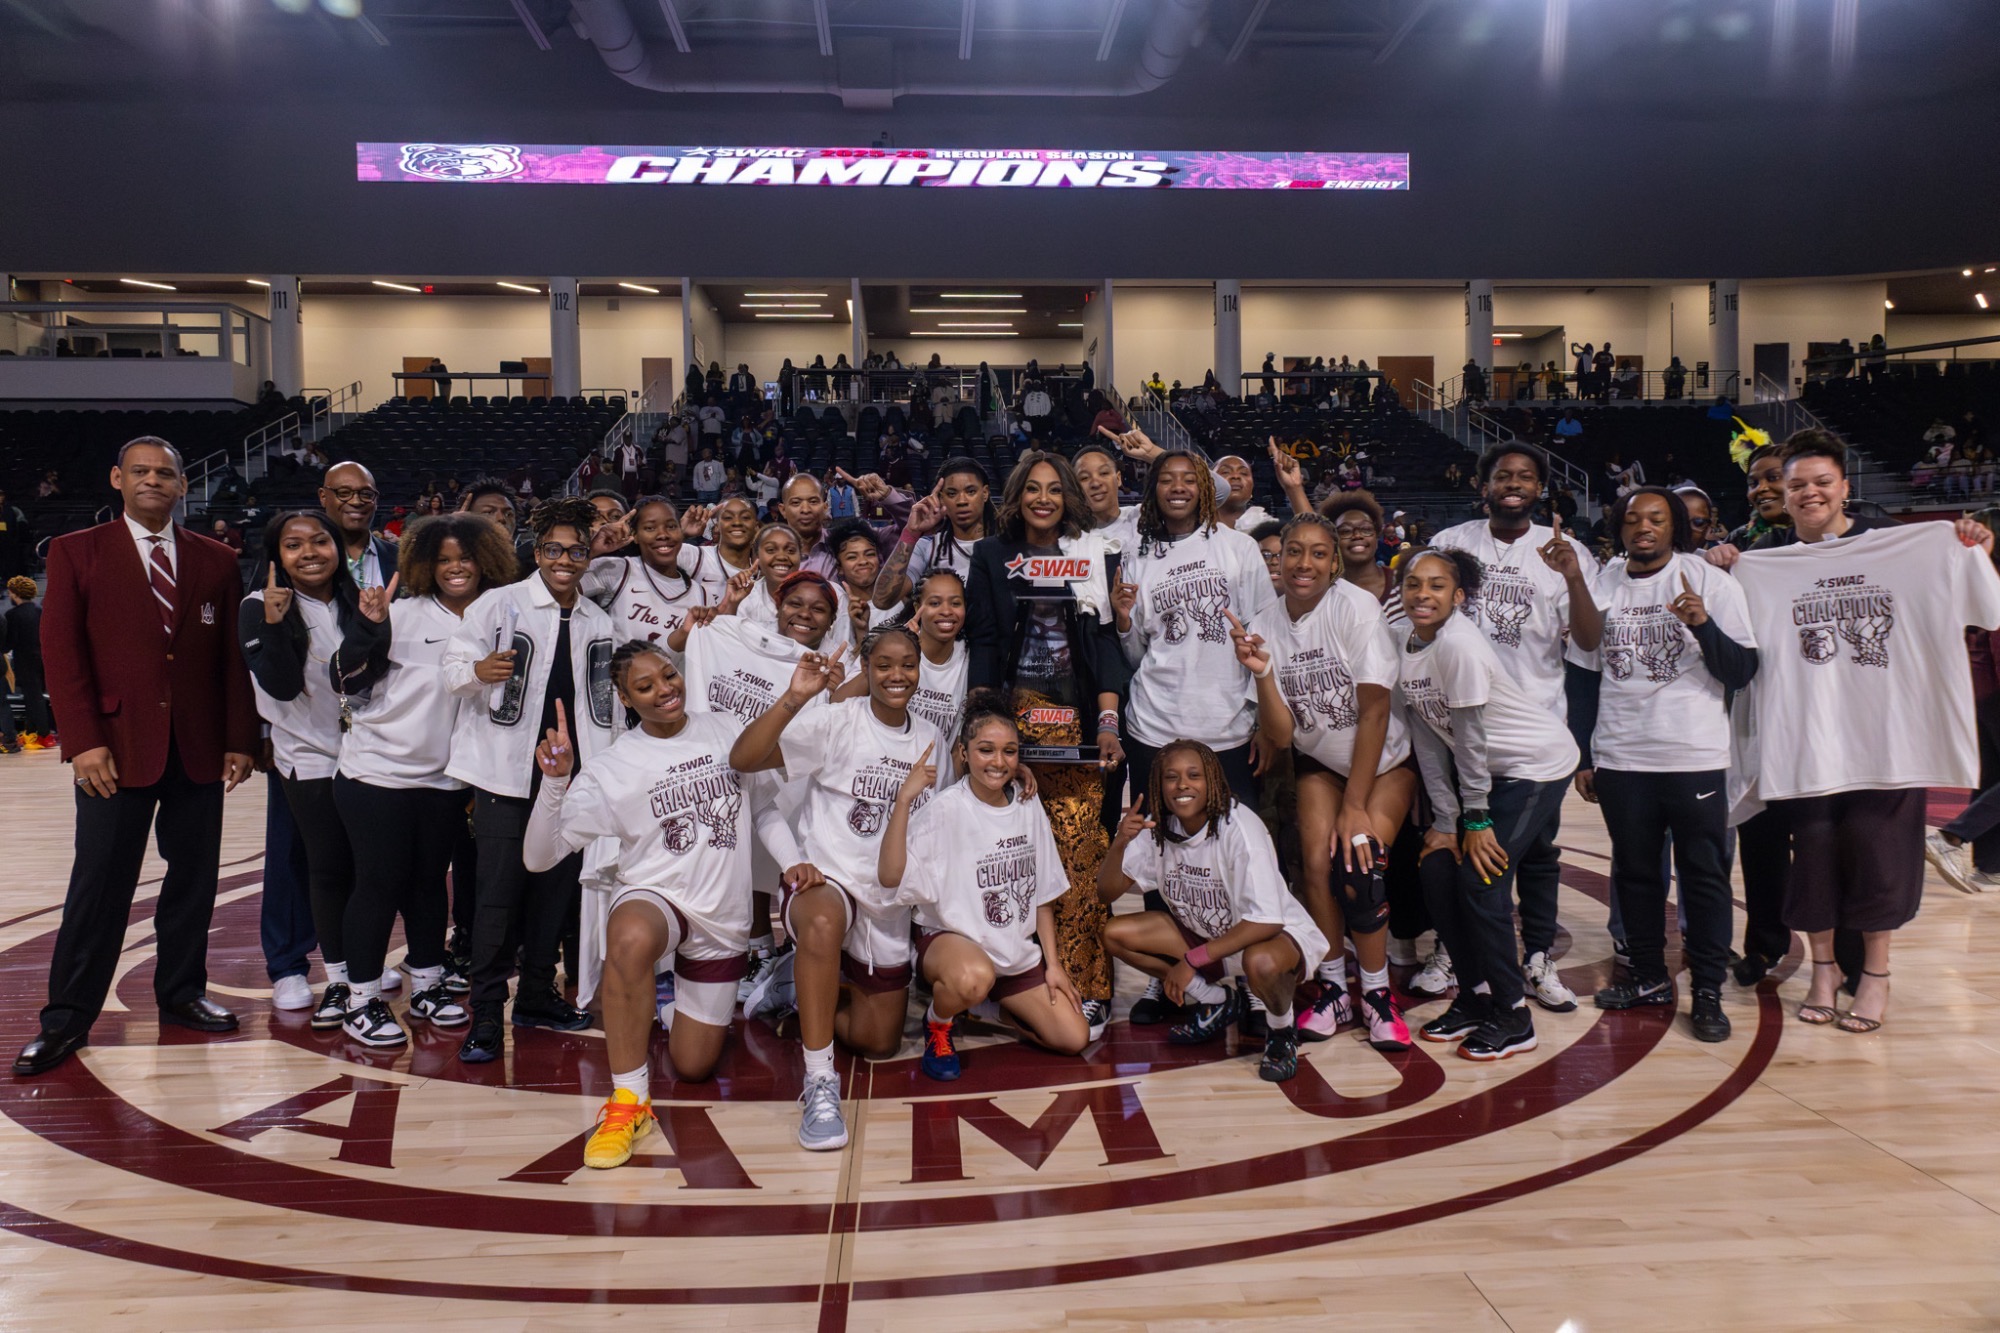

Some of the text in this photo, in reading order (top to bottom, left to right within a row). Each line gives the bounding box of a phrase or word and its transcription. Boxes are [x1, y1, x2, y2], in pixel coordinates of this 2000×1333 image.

[714, 148, 805, 157] SWAC
[936, 150, 1039, 159] REGULAR
[1045, 152, 1134, 160] SEASON
[606, 156, 1169, 187] CHAMPIONS
[273, 291, 287, 309] 111
[554, 293, 570, 311] 112
[1223, 294, 1237, 312] 114
[1029, 559, 1090, 577] SWAC
[1177, 560, 1206, 575] SWAC
[1150, 570, 1226, 594] WOMEN'S BASKETBALL
[1828, 575, 1864, 588] SWAC
[1152, 575, 1230, 613] CHAMPIONS
[1792, 589, 1892, 603] WOMEN'S BASKETBALL
[628, 603, 659, 625] The
[1632, 605, 1662, 616] SWAC
[1792, 594, 1894, 626] CHAMPIONS
[1299, 648, 1324, 662] SWAC
[712, 675, 776, 703] WOMEN'S BASKETB
[743, 673, 774, 691] SWAC
[709, 680, 772, 720] CHAMPIO
[923, 689, 952, 703] SWAC
[1030, 709, 1074, 723] SWAC
[679, 755, 713, 772] SWAC
[891, 759, 914, 771] SWA
[676, 768, 703, 779] REGULAR
[856, 769, 892, 777] WOMEN'S
[647, 779, 686, 795] WOMEN'S
[650, 770, 741, 818] CHAMPIONS
[976, 854, 1009, 865] WOMEN'S
[1185, 865, 1210, 877] SWAC
